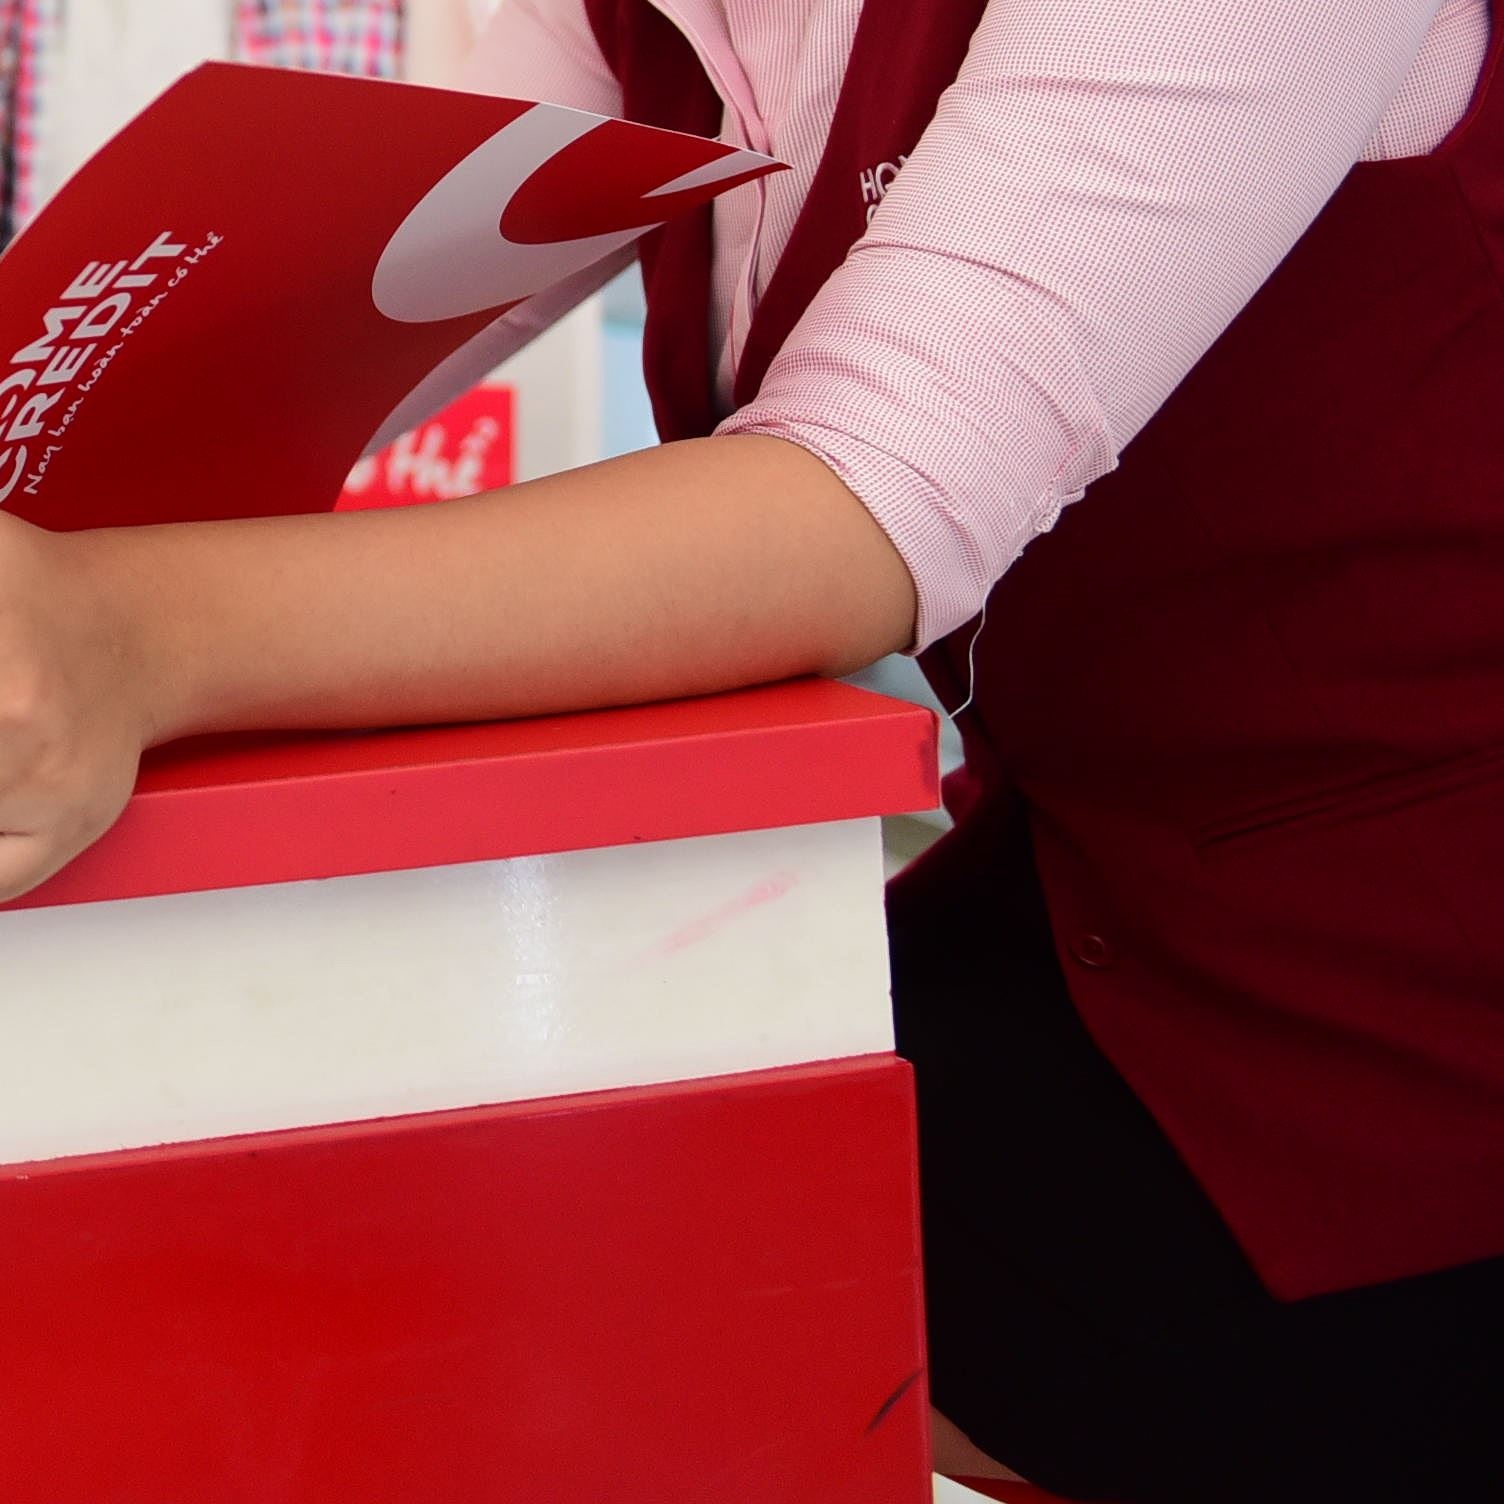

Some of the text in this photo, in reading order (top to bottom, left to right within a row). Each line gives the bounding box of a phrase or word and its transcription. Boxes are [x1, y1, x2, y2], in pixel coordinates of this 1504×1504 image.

[23, 444, 64, 495] Nay
[48, 397, 84, 437] bạn
[78, 342, 124, 392] hoàn
[120, 291, 169, 337] toàn
[167, 265, 190, 288] có
